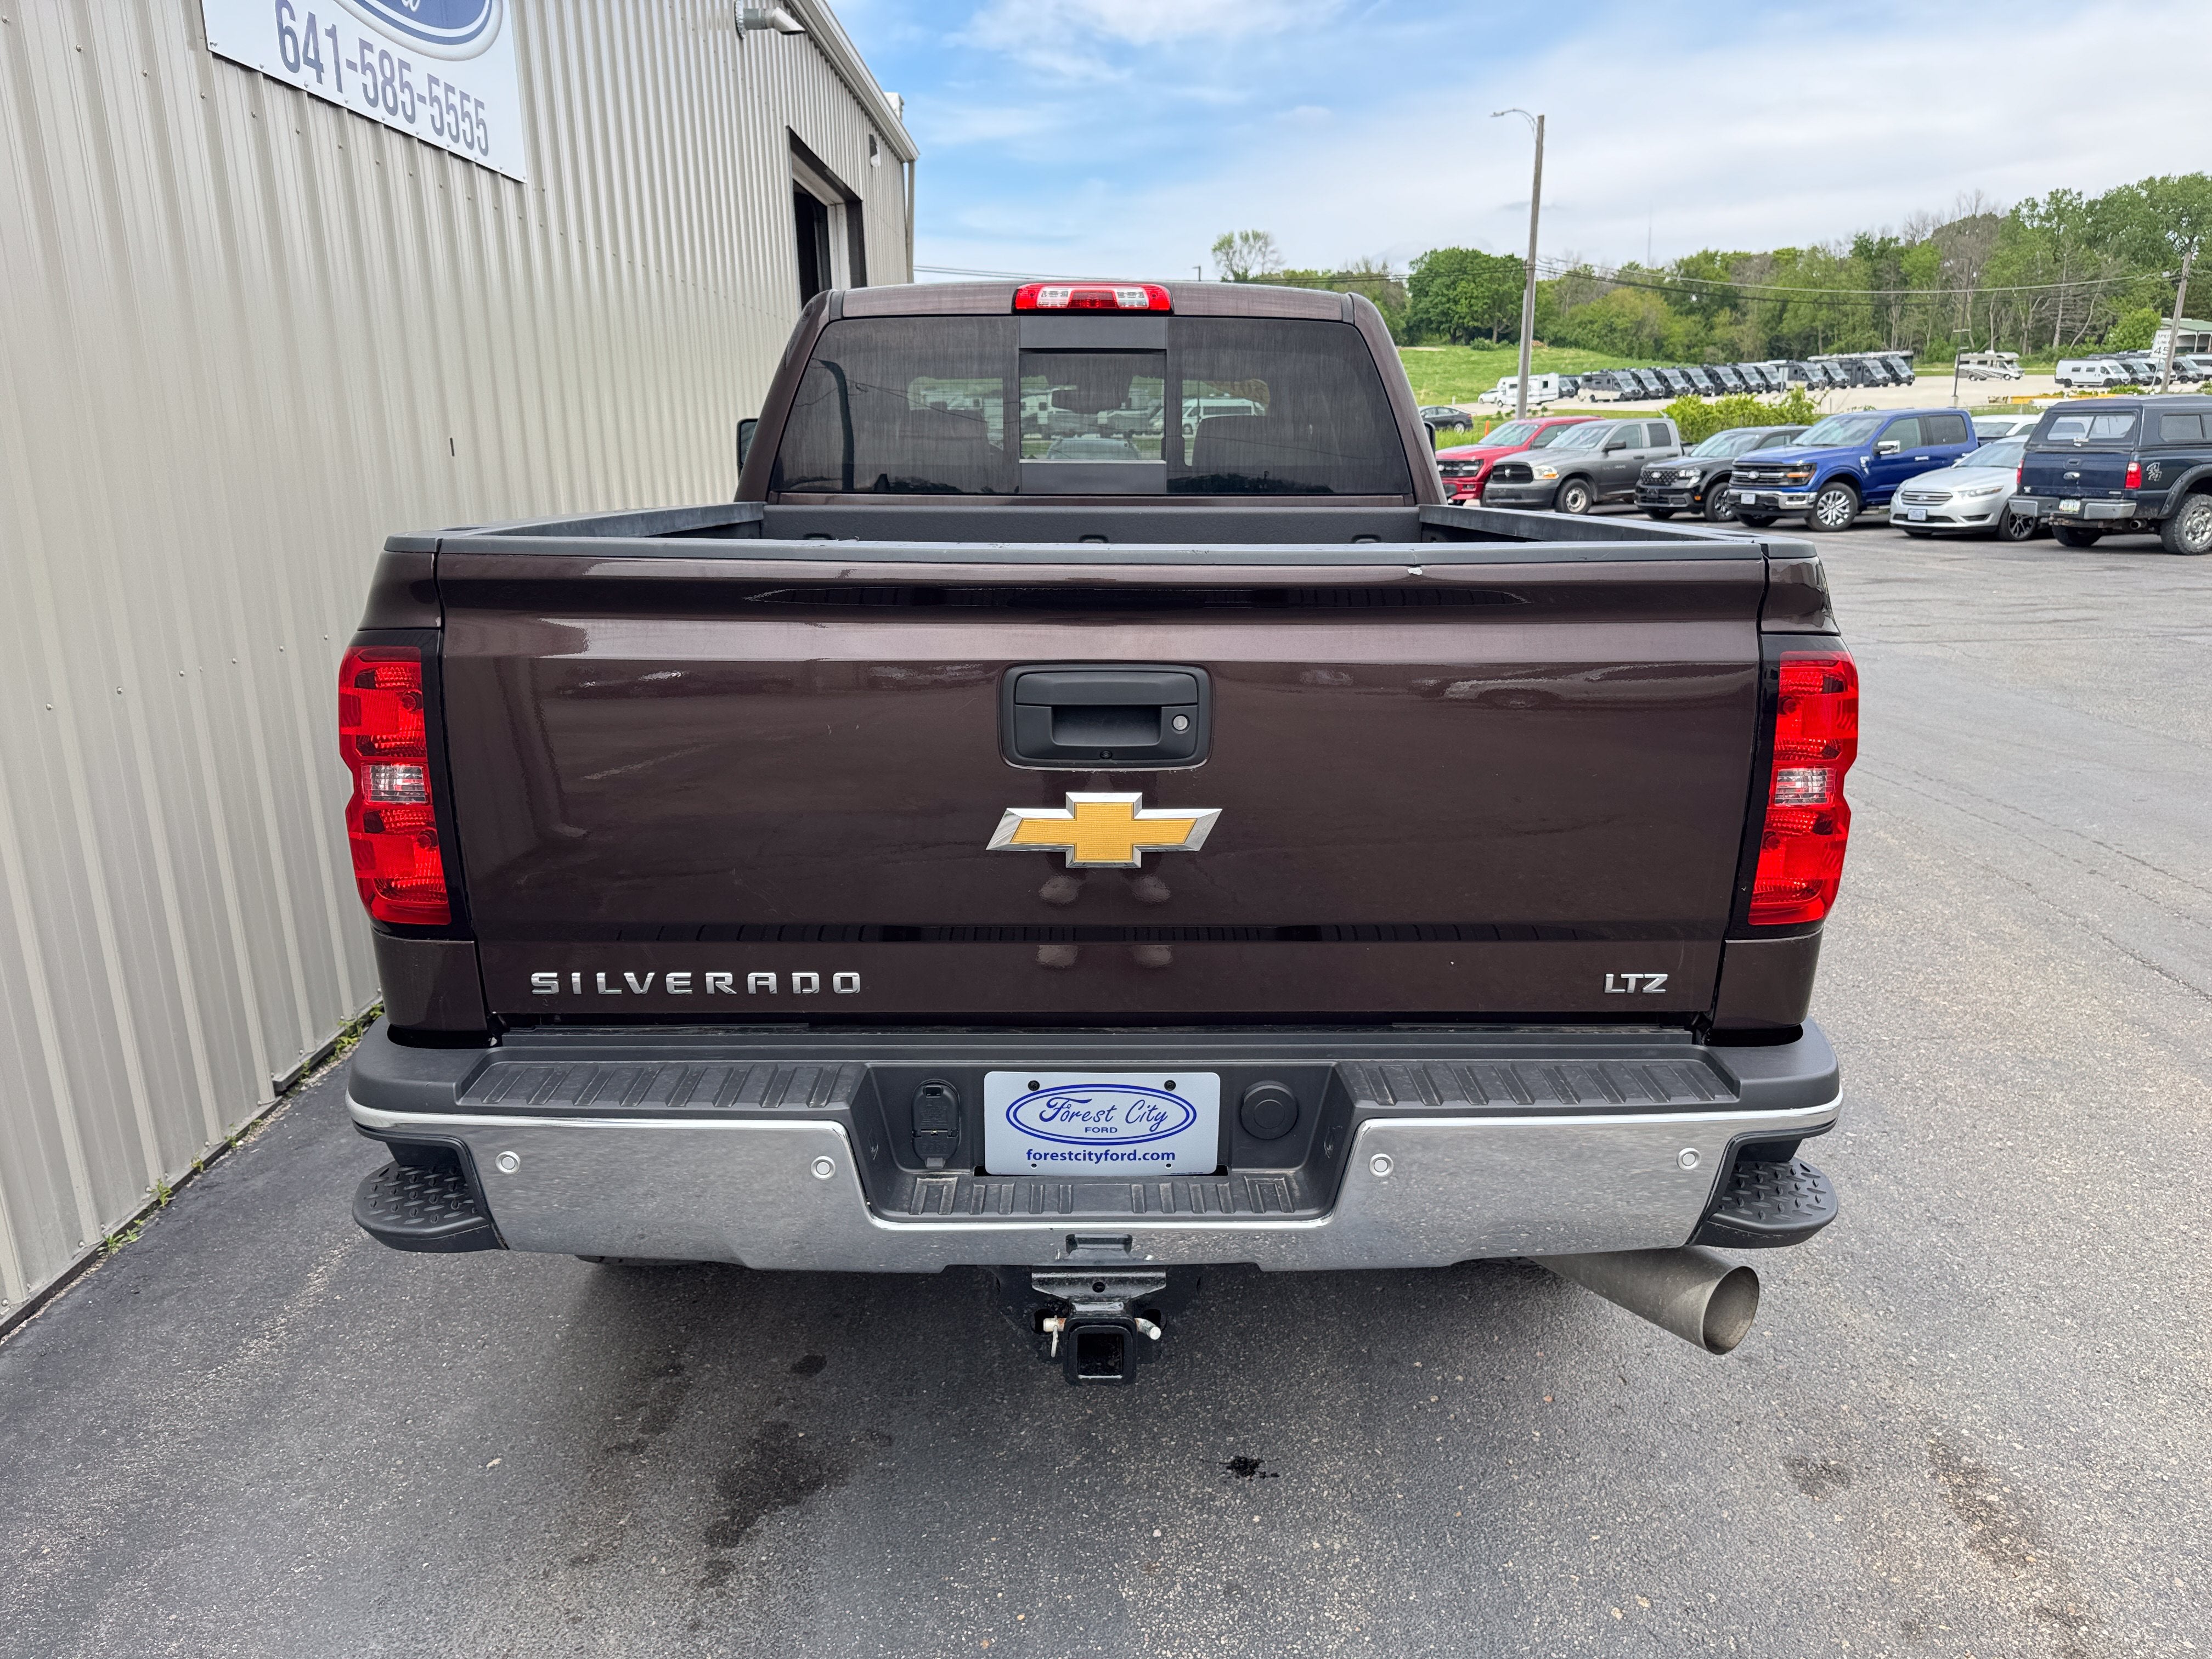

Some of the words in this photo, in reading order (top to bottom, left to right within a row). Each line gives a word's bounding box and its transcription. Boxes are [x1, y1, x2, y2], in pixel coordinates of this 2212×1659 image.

[274, 0, 489, 157] 641-585-5555
[531, 972, 862, 995] SILVERADO
[1604, 973, 1668, 994] LTZ
[1039, 1097, 1118, 1122] Forest
[1125, 1099, 1169, 1132] City
[1026, 1149, 1176, 1164] forestcityford.com
